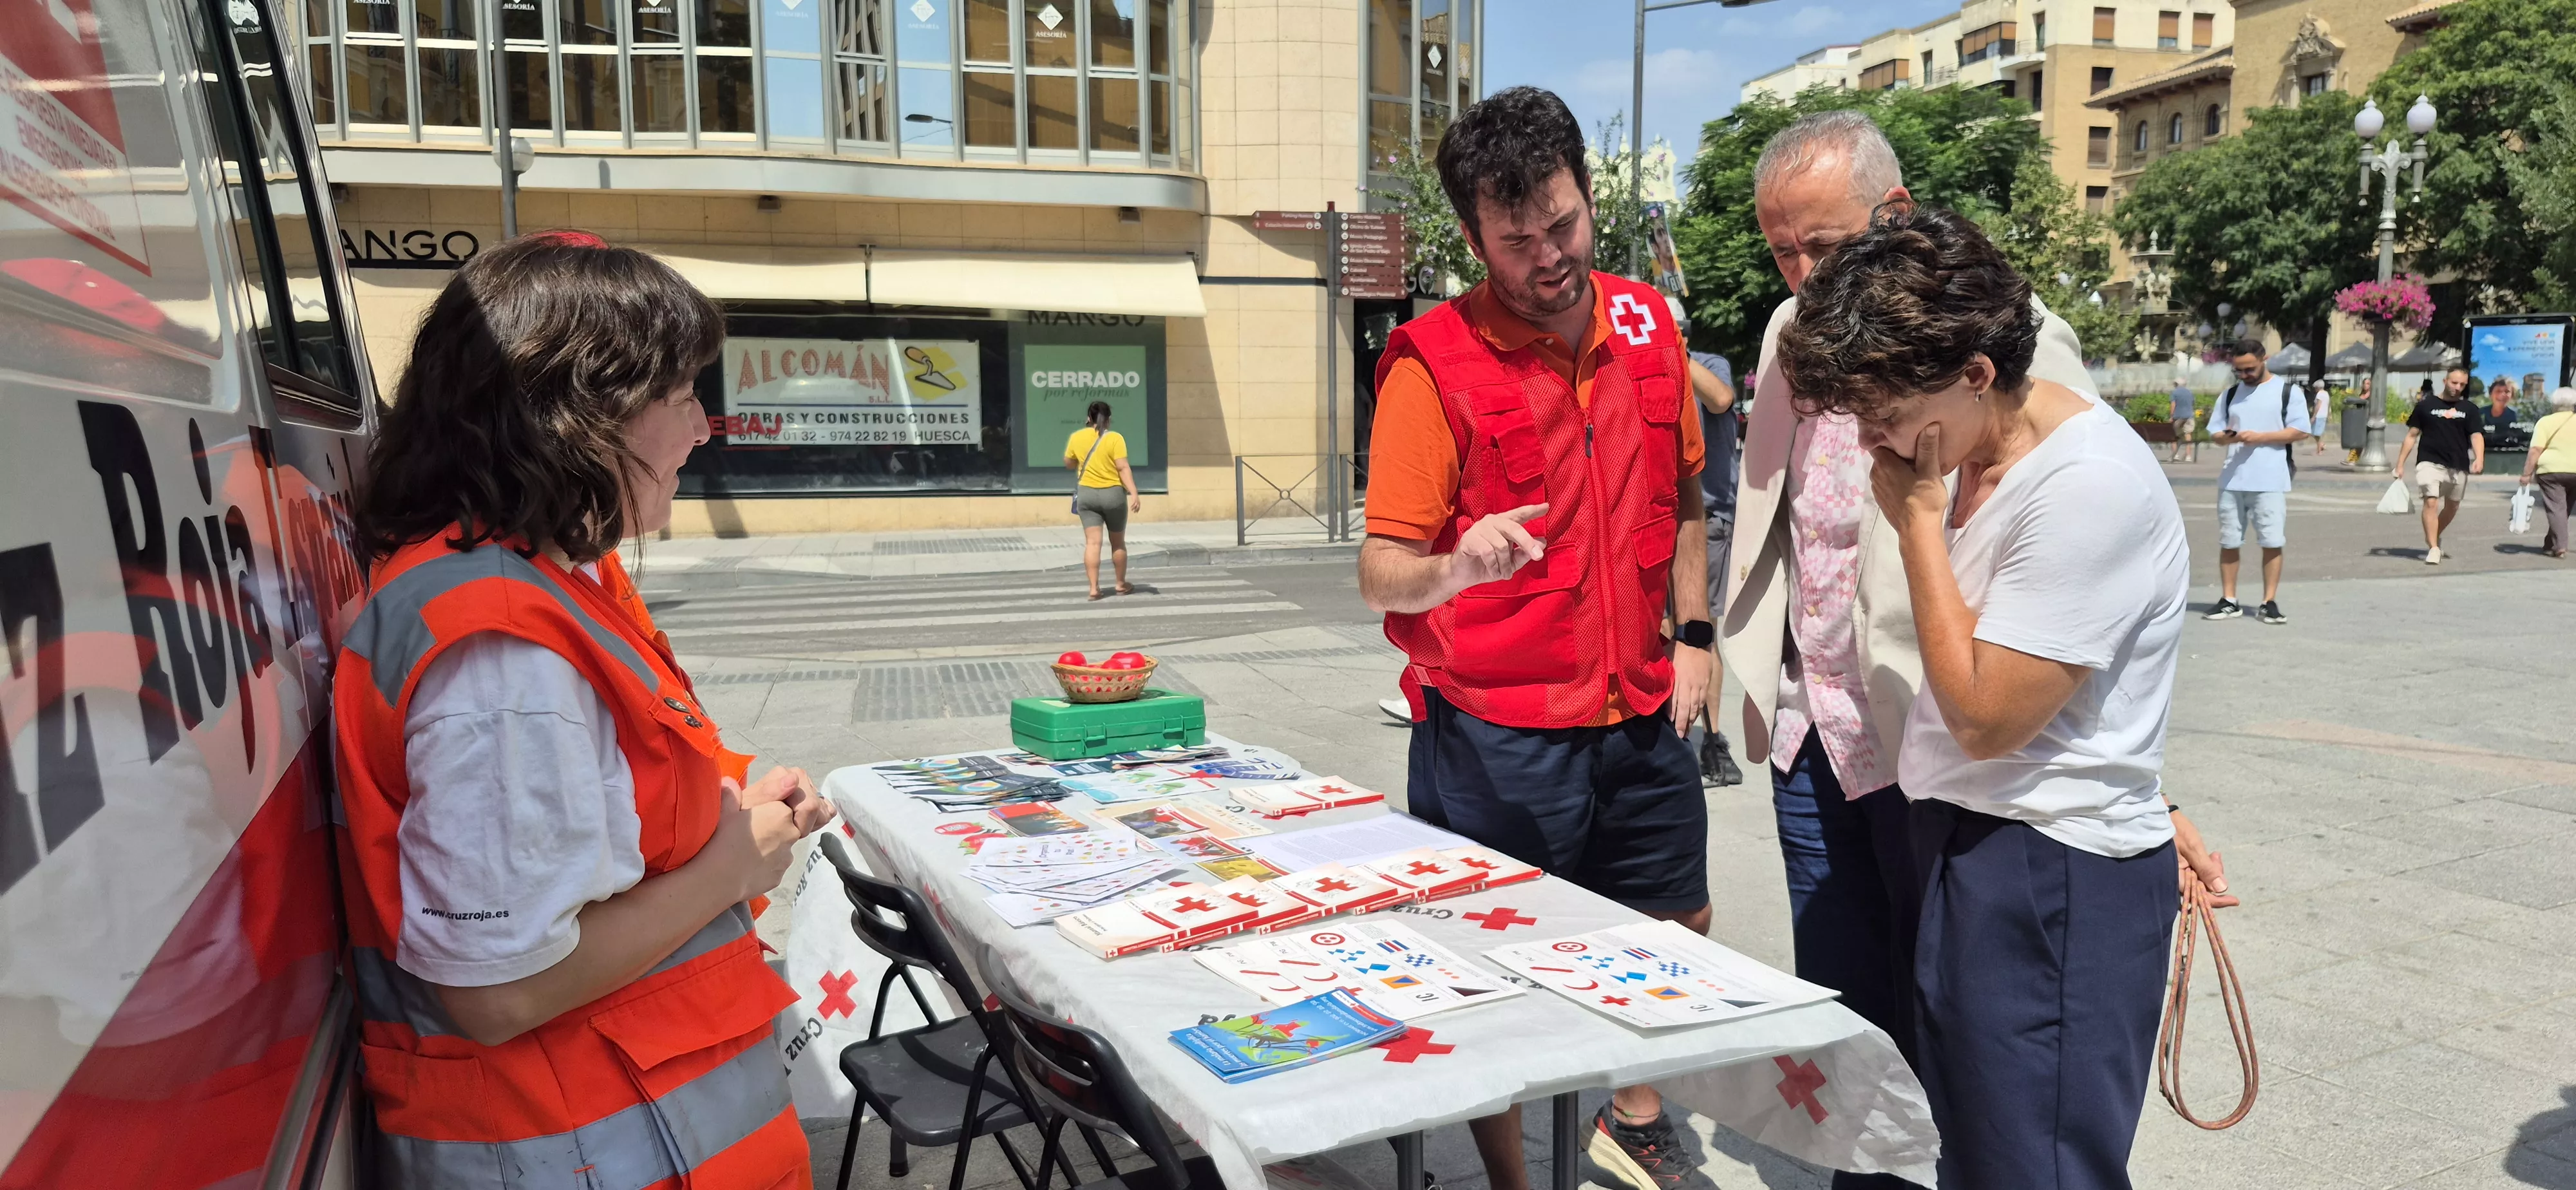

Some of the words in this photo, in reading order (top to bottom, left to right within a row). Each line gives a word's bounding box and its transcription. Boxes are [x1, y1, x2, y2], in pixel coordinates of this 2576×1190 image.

[1036, 30, 1067, 39] ASESORÍA
[341, 229, 479, 261] ANGO
[737, 344, 890, 396] ALCOMÁN
[1032, 371, 1140, 388] CERRADO
[1043, 389, 1068, 402] por
[800, 413, 810, 424] Y
[815, 413, 969, 424] CONSTRUCCIONES
[783, 431, 797, 441] 01
[802, 431, 816, 441] 32
[830, 431, 851, 441] 974
[855, 431, 870, 441] 22
[873, 431, 889, 441] 82
[893, 431, 907, 442] 19
[914, 431, 971, 442] HUESCA
[77, 400, 274, 775] Roja
[422, 907, 509, 921] www.cruzroja.es
[1390, 905, 1454, 920] Cruz
[1416, 993, 1439, 1002] IC
[784, 1017, 823, 1062] Cruz
